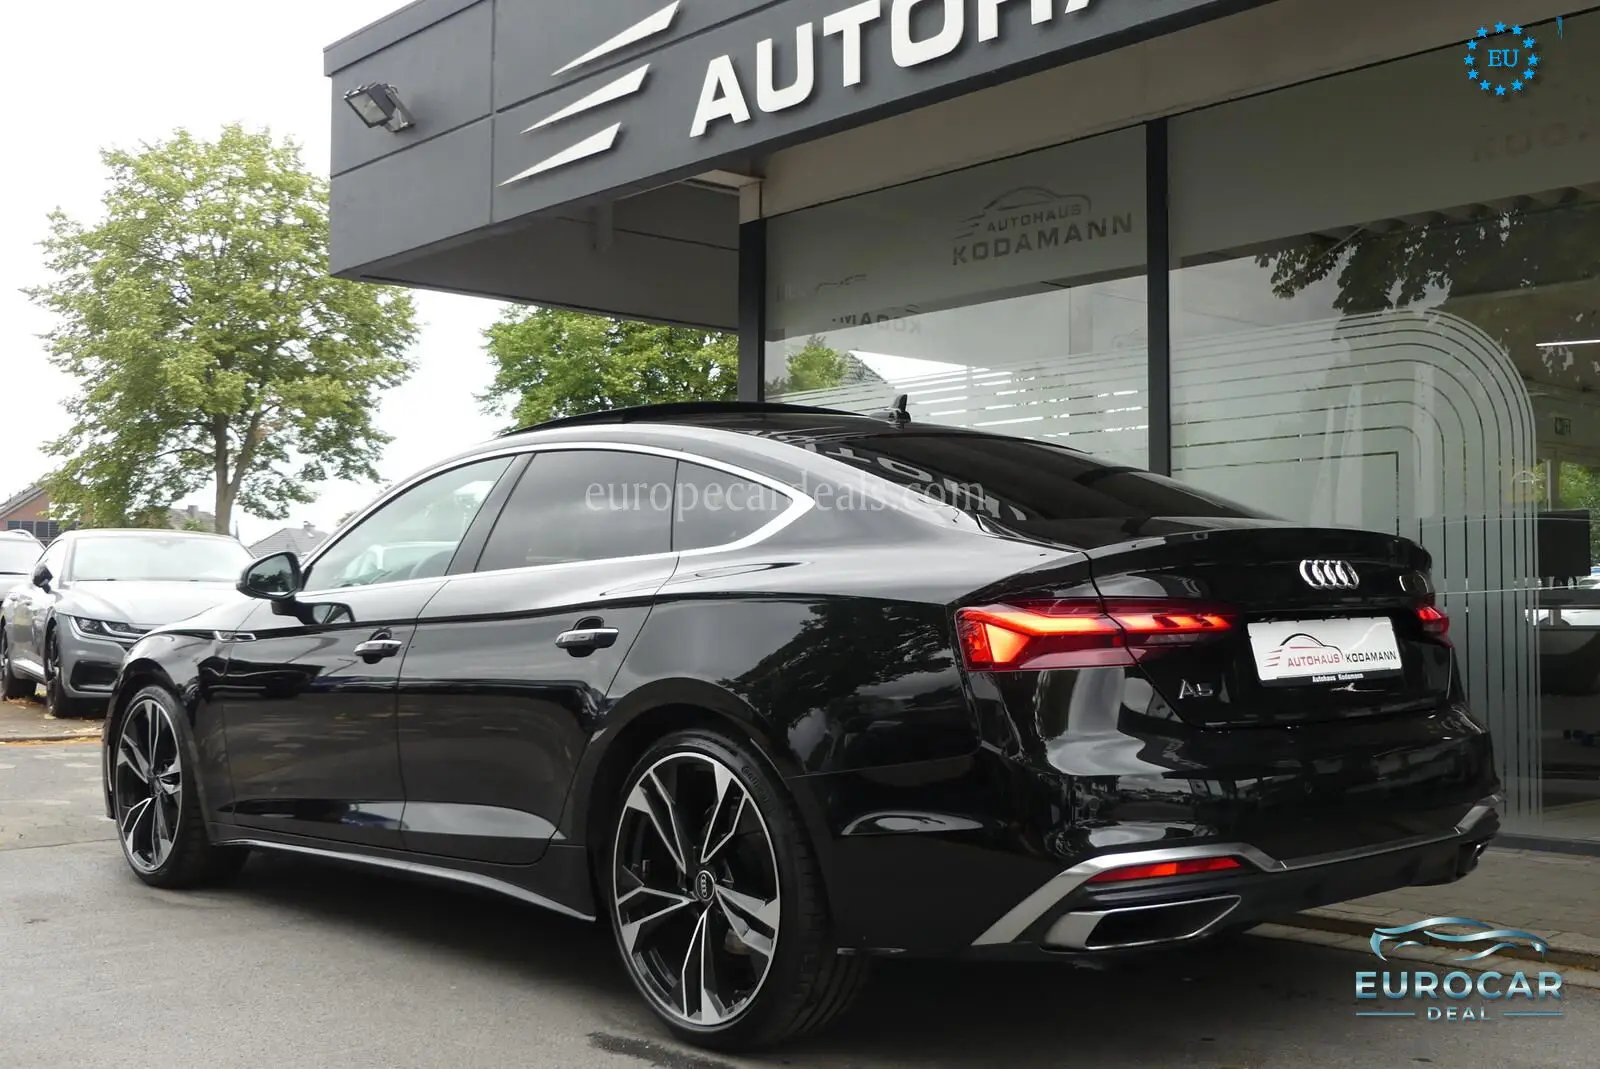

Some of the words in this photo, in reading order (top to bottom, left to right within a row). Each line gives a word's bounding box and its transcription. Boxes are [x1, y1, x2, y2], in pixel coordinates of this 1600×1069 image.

[987, 204, 1082, 233] AUTOHAUS
[952, 212, 1133, 266] KODAMANN
[1287, 653, 1341, 668] AUTOHAUS
[1346, 651, 1397, 664] KODAMANN
[1178, 678, 1213, 700] A5
